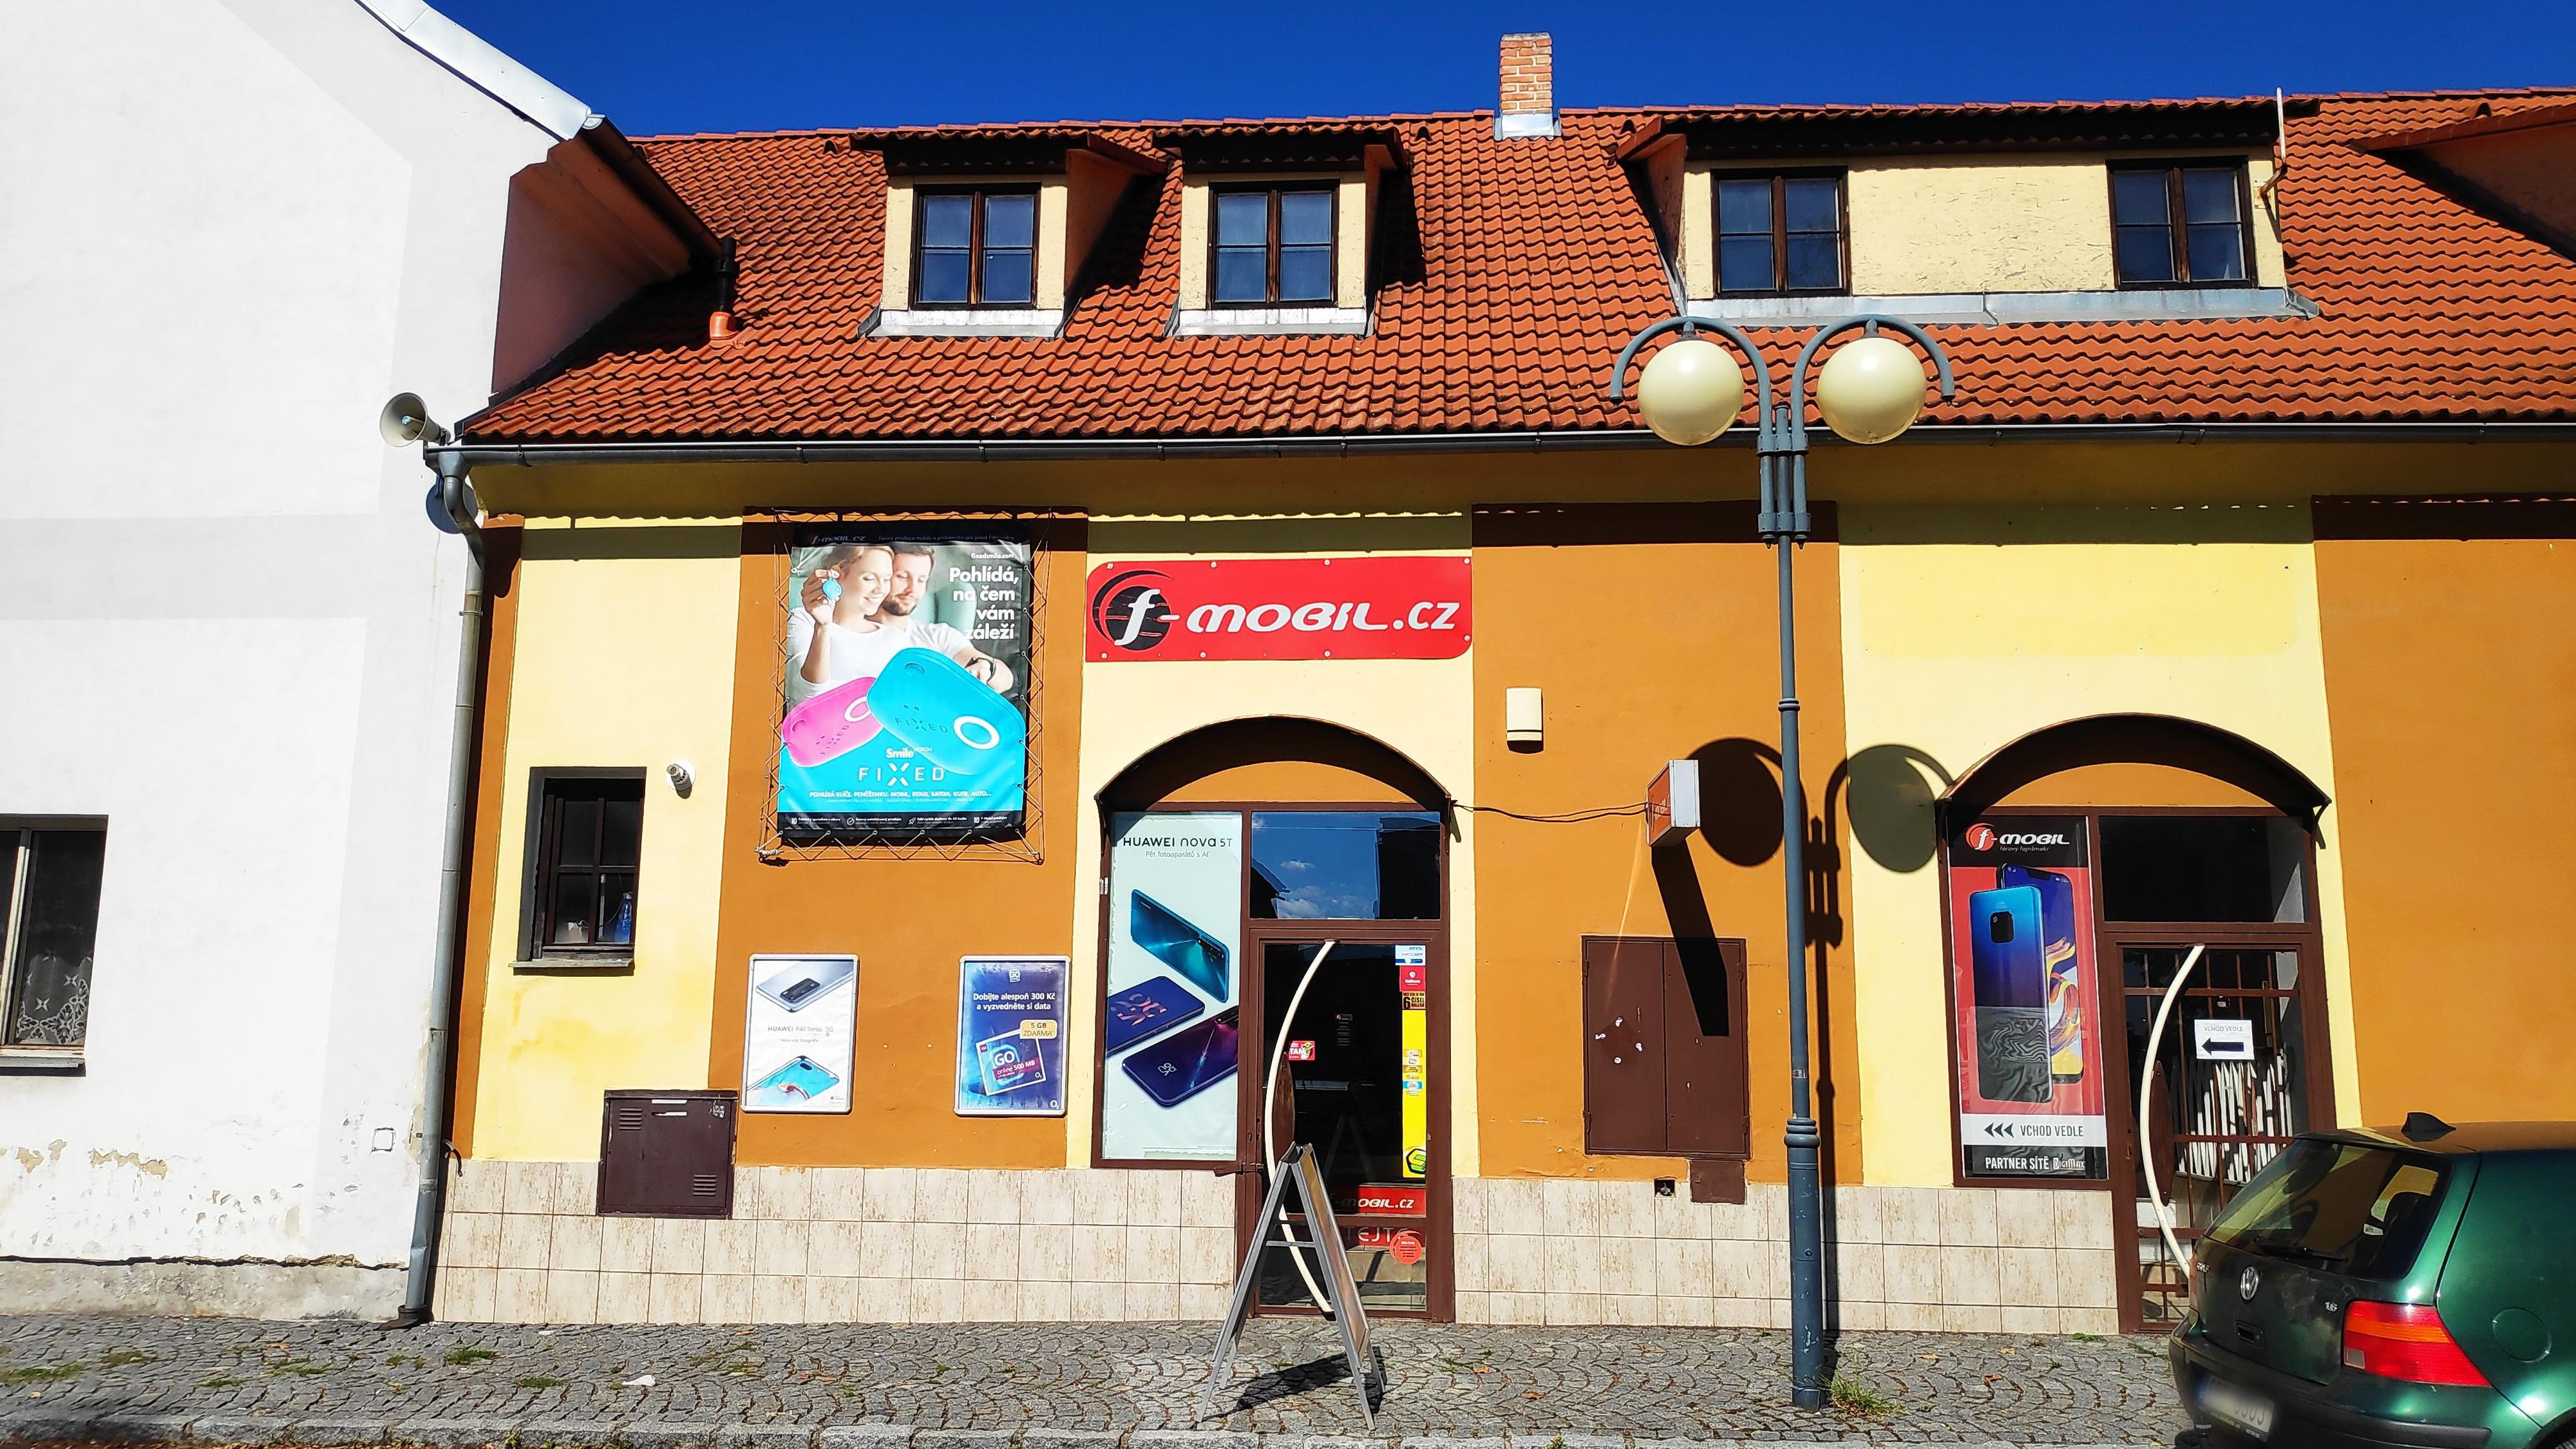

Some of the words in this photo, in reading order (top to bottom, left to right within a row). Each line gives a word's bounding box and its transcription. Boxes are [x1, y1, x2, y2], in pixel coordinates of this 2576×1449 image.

[949, 565, 1019, 585] Pohlídá,
[953, 590, 976, 601] na
[980, 585, 1015, 601] čem
[976, 604, 1015, 620] vám
[964, 623, 1015, 639] záleží
[886, 746, 914, 758] Smile
[858, 762, 945, 786] FIXED
[1123, 837, 1175, 847] HUAWEI
[1180, 837, 1217, 847] nova
[1220, 838, 1233, 847] 5T
[1157, 850, 1195, 858] fotoaparátů
[973, 992, 999, 1002] Dobijte
[1001, 992, 1029, 1001] alespoň
[1403, 997, 1410, 1009] 6
[983, 1003, 1025, 1012] vyzvedněte
[994, 1050, 1015, 1066] GO
[1014, 1063, 1025, 1071] 500
[2020, 1124, 2051, 1137] VCHOD
[2054, 1125, 2084, 1137] VEDLE
[1985, 1157, 2028, 1170] PARTNER
[2029, 1155, 2050, 1170] SÍTĚ
